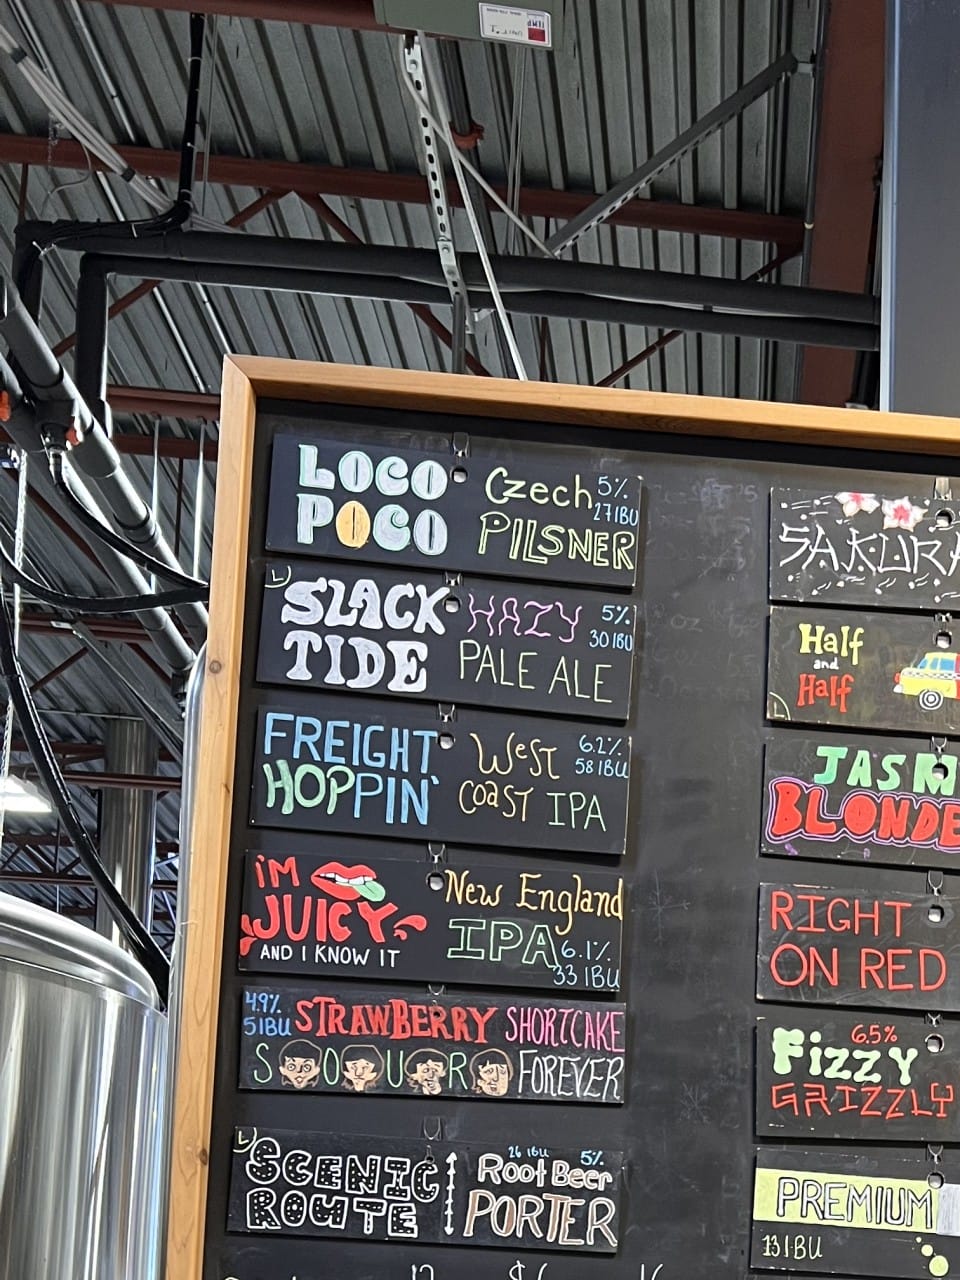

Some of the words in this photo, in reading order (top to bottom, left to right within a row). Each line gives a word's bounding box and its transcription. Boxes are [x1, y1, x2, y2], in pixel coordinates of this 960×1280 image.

[298, 444, 448, 500] LOCO
[485, 467, 593, 509] Czech
[597, 476, 628, 500] 5%
[296, 494, 448, 555] POCO
[479, 511, 635, 571] PILSNER
[281, 577, 450, 635] SLACK
[468, 593, 583, 643] HAZY
[602, 605, 630, 626] 5%
[283, 630, 429, 693] TIDE
[798, 624, 864, 665] Half
[814, 657, 839, 670] and
[459, 640, 537, 689] PALE
[548, 655, 613, 703] ALE
[796, 674, 854, 713] Half
[263, 712, 438, 774] FREIGHT
[547, 792, 606, 832] IPA
[252, 895, 398, 943] JUICY
[444, 870, 503, 907] New
[516, 872, 623, 935] England
[771, 891, 912, 937] RIGHT
[261, 944, 293, 961] AND
[301, 946, 307, 962] I
[315, 946, 367, 966] KNOW
[380, 949, 400, 968] IT
[448, 918, 560, 968] IPA
[560, 941, 611, 962] 6.1%
[770, 944, 839, 987] ON
[860, 947, 947, 992] RED
[295, 996, 498, 1043] STRAWBERRY
[505, 1006, 625, 1053] SHORTCAKE
[851, 1024, 898, 1044] 6.5%
[518, 1049, 624, 1100] FOREVER
[771, 1083, 954, 1120] GRIZZLY
[245, 1137, 439, 1202] SCENIC
[477, 1152, 546, 1187] Root
[551, 1162, 613, 1191] Beer
[580, 1150, 604, 1166] 5%
[246, 1187, 419, 1238] ROUTE
[463, 1189, 618, 1248] PORTER
[776, 1177, 933, 1229] PREMIUM
